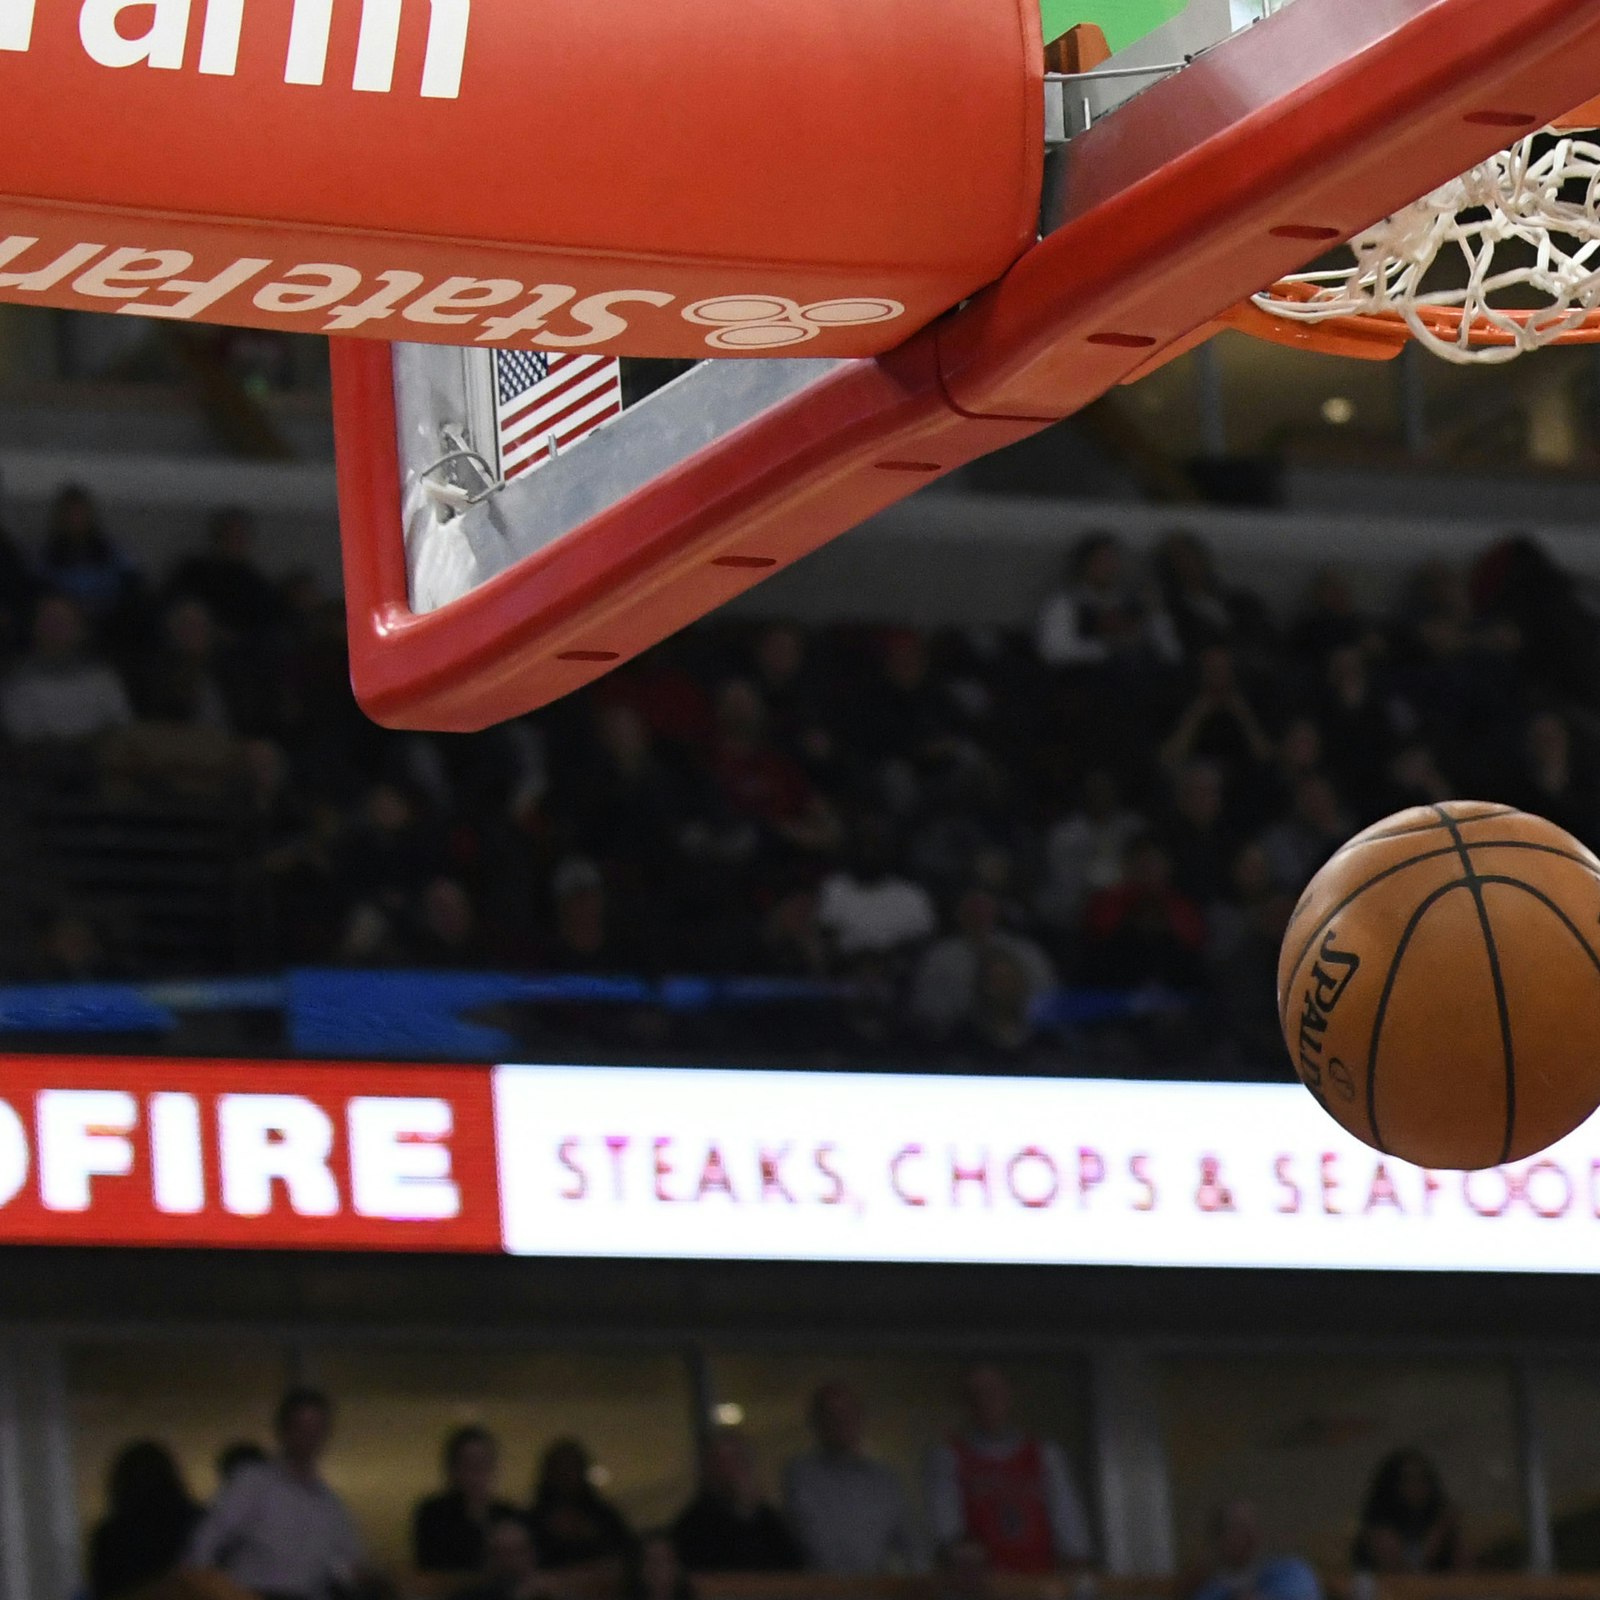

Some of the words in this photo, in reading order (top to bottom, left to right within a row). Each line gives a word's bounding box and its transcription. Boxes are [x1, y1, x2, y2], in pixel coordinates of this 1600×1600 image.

[0, 235, 675, 348] StateFar
[1300, 929, 1361, 1094] SPALD
[889, 1142, 1157, 1214] CHOPS
